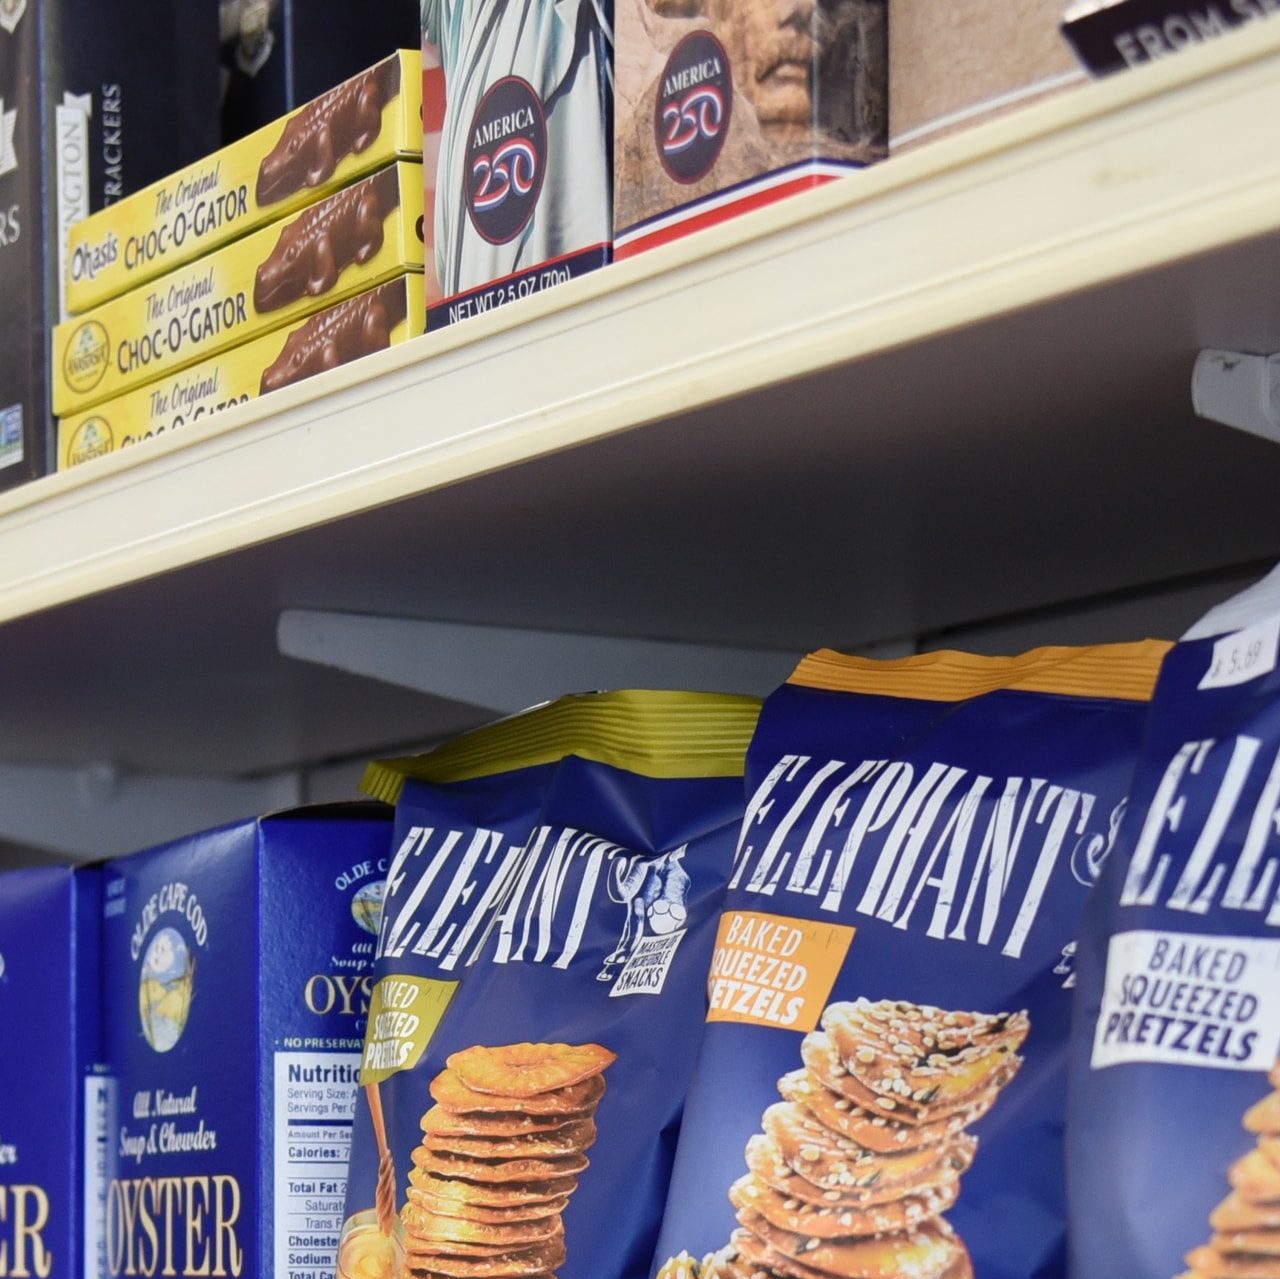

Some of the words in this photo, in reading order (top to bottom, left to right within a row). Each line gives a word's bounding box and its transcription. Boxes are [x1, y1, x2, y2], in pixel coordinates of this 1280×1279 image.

[1114, 9, 1223, 69] FROM
[663, 57, 721, 98] AMERICA
[473, 107, 534, 149] AMERICA
[664, 85, 723, 155] 250
[155, 189, 172, 217] The
[175, 160, 221, 212] Original
[474, 137, 538, 212] 250
[124, 185, 248, 269] CHOC-O-GATOR
[146, 294, 166, 322] The
[168, 267, 215, 319] Original
[449, 301, 472, 325] NET
[475, 292, 495, 315] WT
[498, 284, 515, 306] 2.5
[518, 278, 538, 299] OZ
[117, 292, 247, 374] CHOC-O-GATOR
[150, 390, 170, 418] The
[172, 366, 219, 416] Original
[335, 860, 372, 891] OLDE
[727, 755, 1096, 959] ELEPHANT
[375, 826, 627, 971] ELEPANT
[130, 897, 159, 961] OLDE
[158, 882, 187, 914] CAPE
[185, 893, 208, 947] COD
[726, 914, 804, 957] BAKED
[330, 955, 368, 971] Soup
[616, 967, 664, 991] SNACKS
[712, 948, 807, 992] SQUEEZED
[1148, 938, 1247, 983] BAKED
[304, 974, 373, 1015] OYS
[711, 980, 805, 1025] ETZELS
[1120, 974, 1258, 1023] SQUEEZED
[284, 1038, 301, 1048] NO
[304, 1038, 363, 1049] PRESERVA
[1103, 1011, 1259, 1061] PRETZELS
[288, 1064, 360, 1083] Nutritio
[288, 1088, 323, 1100] Serving
[327, 1088, 349, 1099] Size:
[133, 1090, 151, 1119] All
[151, 1085, 198, 1118] Natural
[288, 1103, 329, 1115] Servings
[332, 1103, 347, 1113] Per
[120, 1126, 146, 1164] Soup
[147, 1124, 158, 1154] &
[159, 1121, 216, 1154] Chowder
[288, 1130, 320, 1139] Amount
[323, 1130, 336, 1139] Per
[288, 1147, 340, 1158] Calories:
[288, 1182, 316, 1193] Total
[320, 1182, 337, 1193] Fat
[305, 1200, 345, 1211] Saturat
[106, 1174, 243, 1279] OYSTER
[288, 1236, 338, 1247] Choleste
[305, 1217, 332, 1229] Trans
[288, 1254, 331, 1265] Sodium
